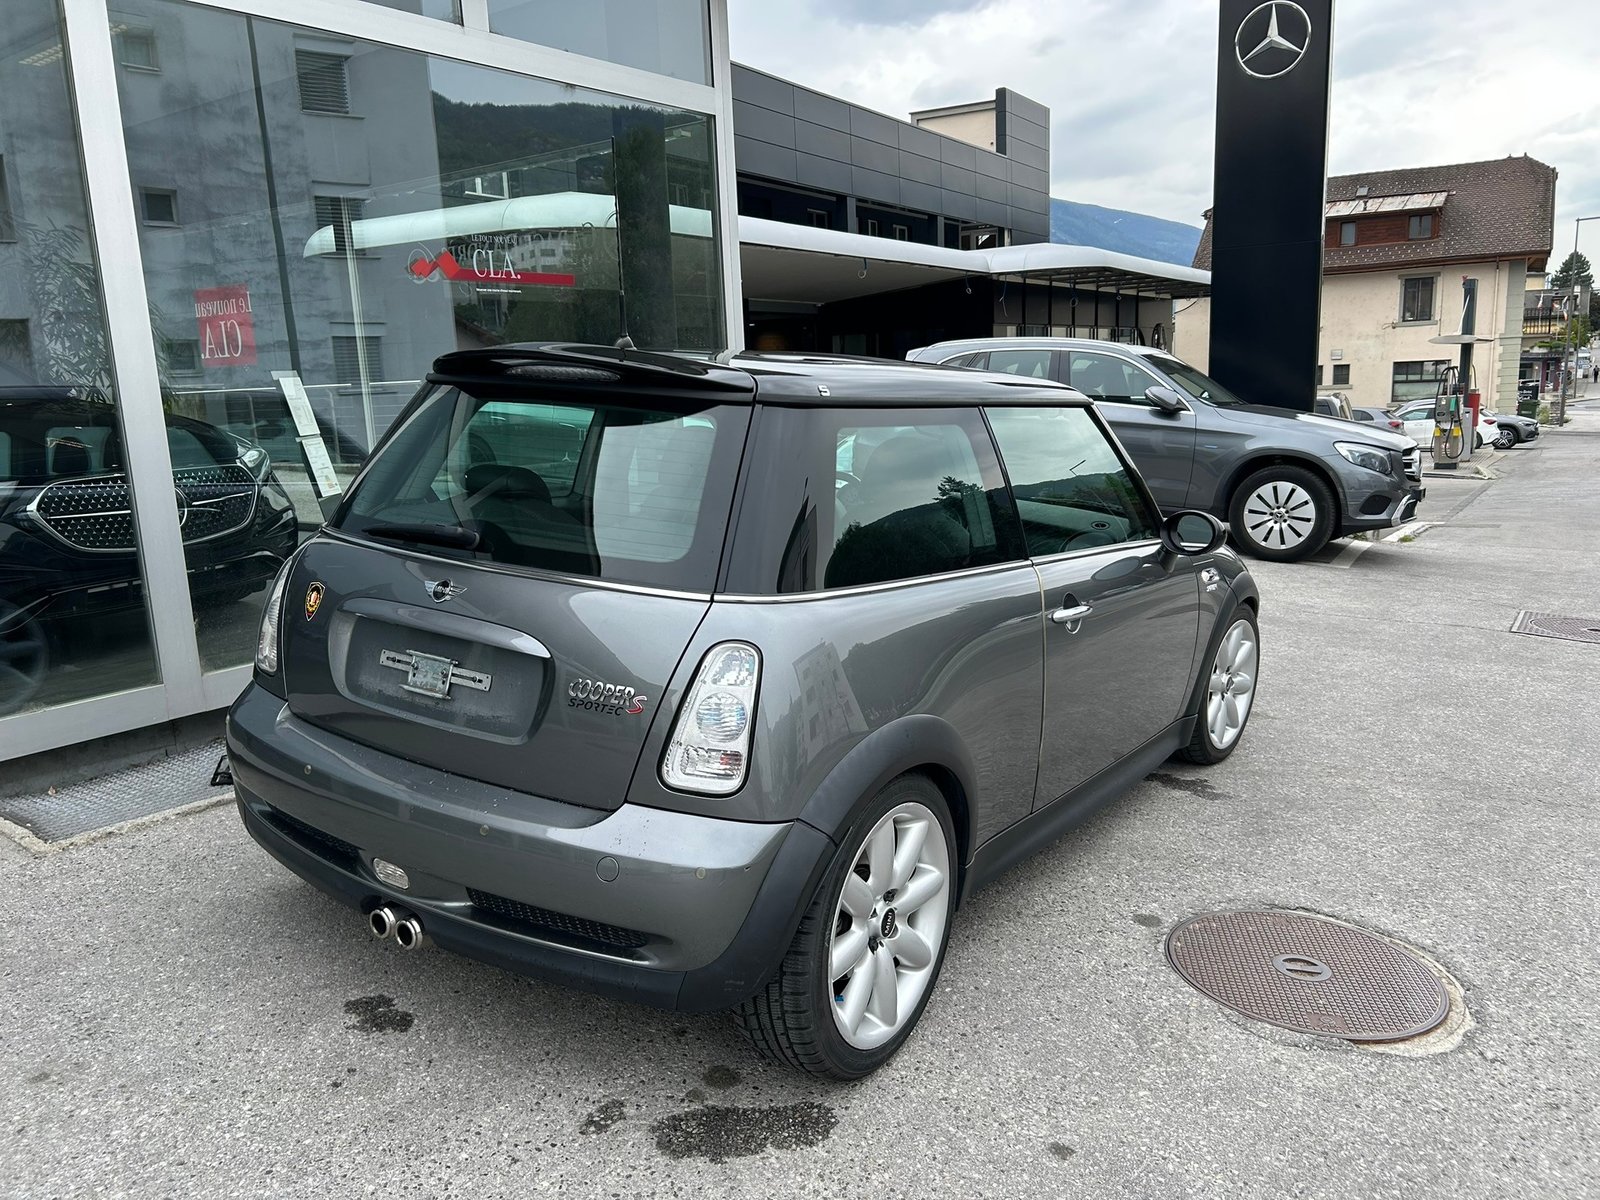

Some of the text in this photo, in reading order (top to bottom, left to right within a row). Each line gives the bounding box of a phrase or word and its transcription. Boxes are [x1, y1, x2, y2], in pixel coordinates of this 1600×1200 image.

[473, 249, 521, 279] CLA.
[817, 384, 831, 397] S
[568, 678, 648, 714] COOPER S
[568, 698, 624, 716] SPORTEC
[884, 912, 893, 934] MINI
